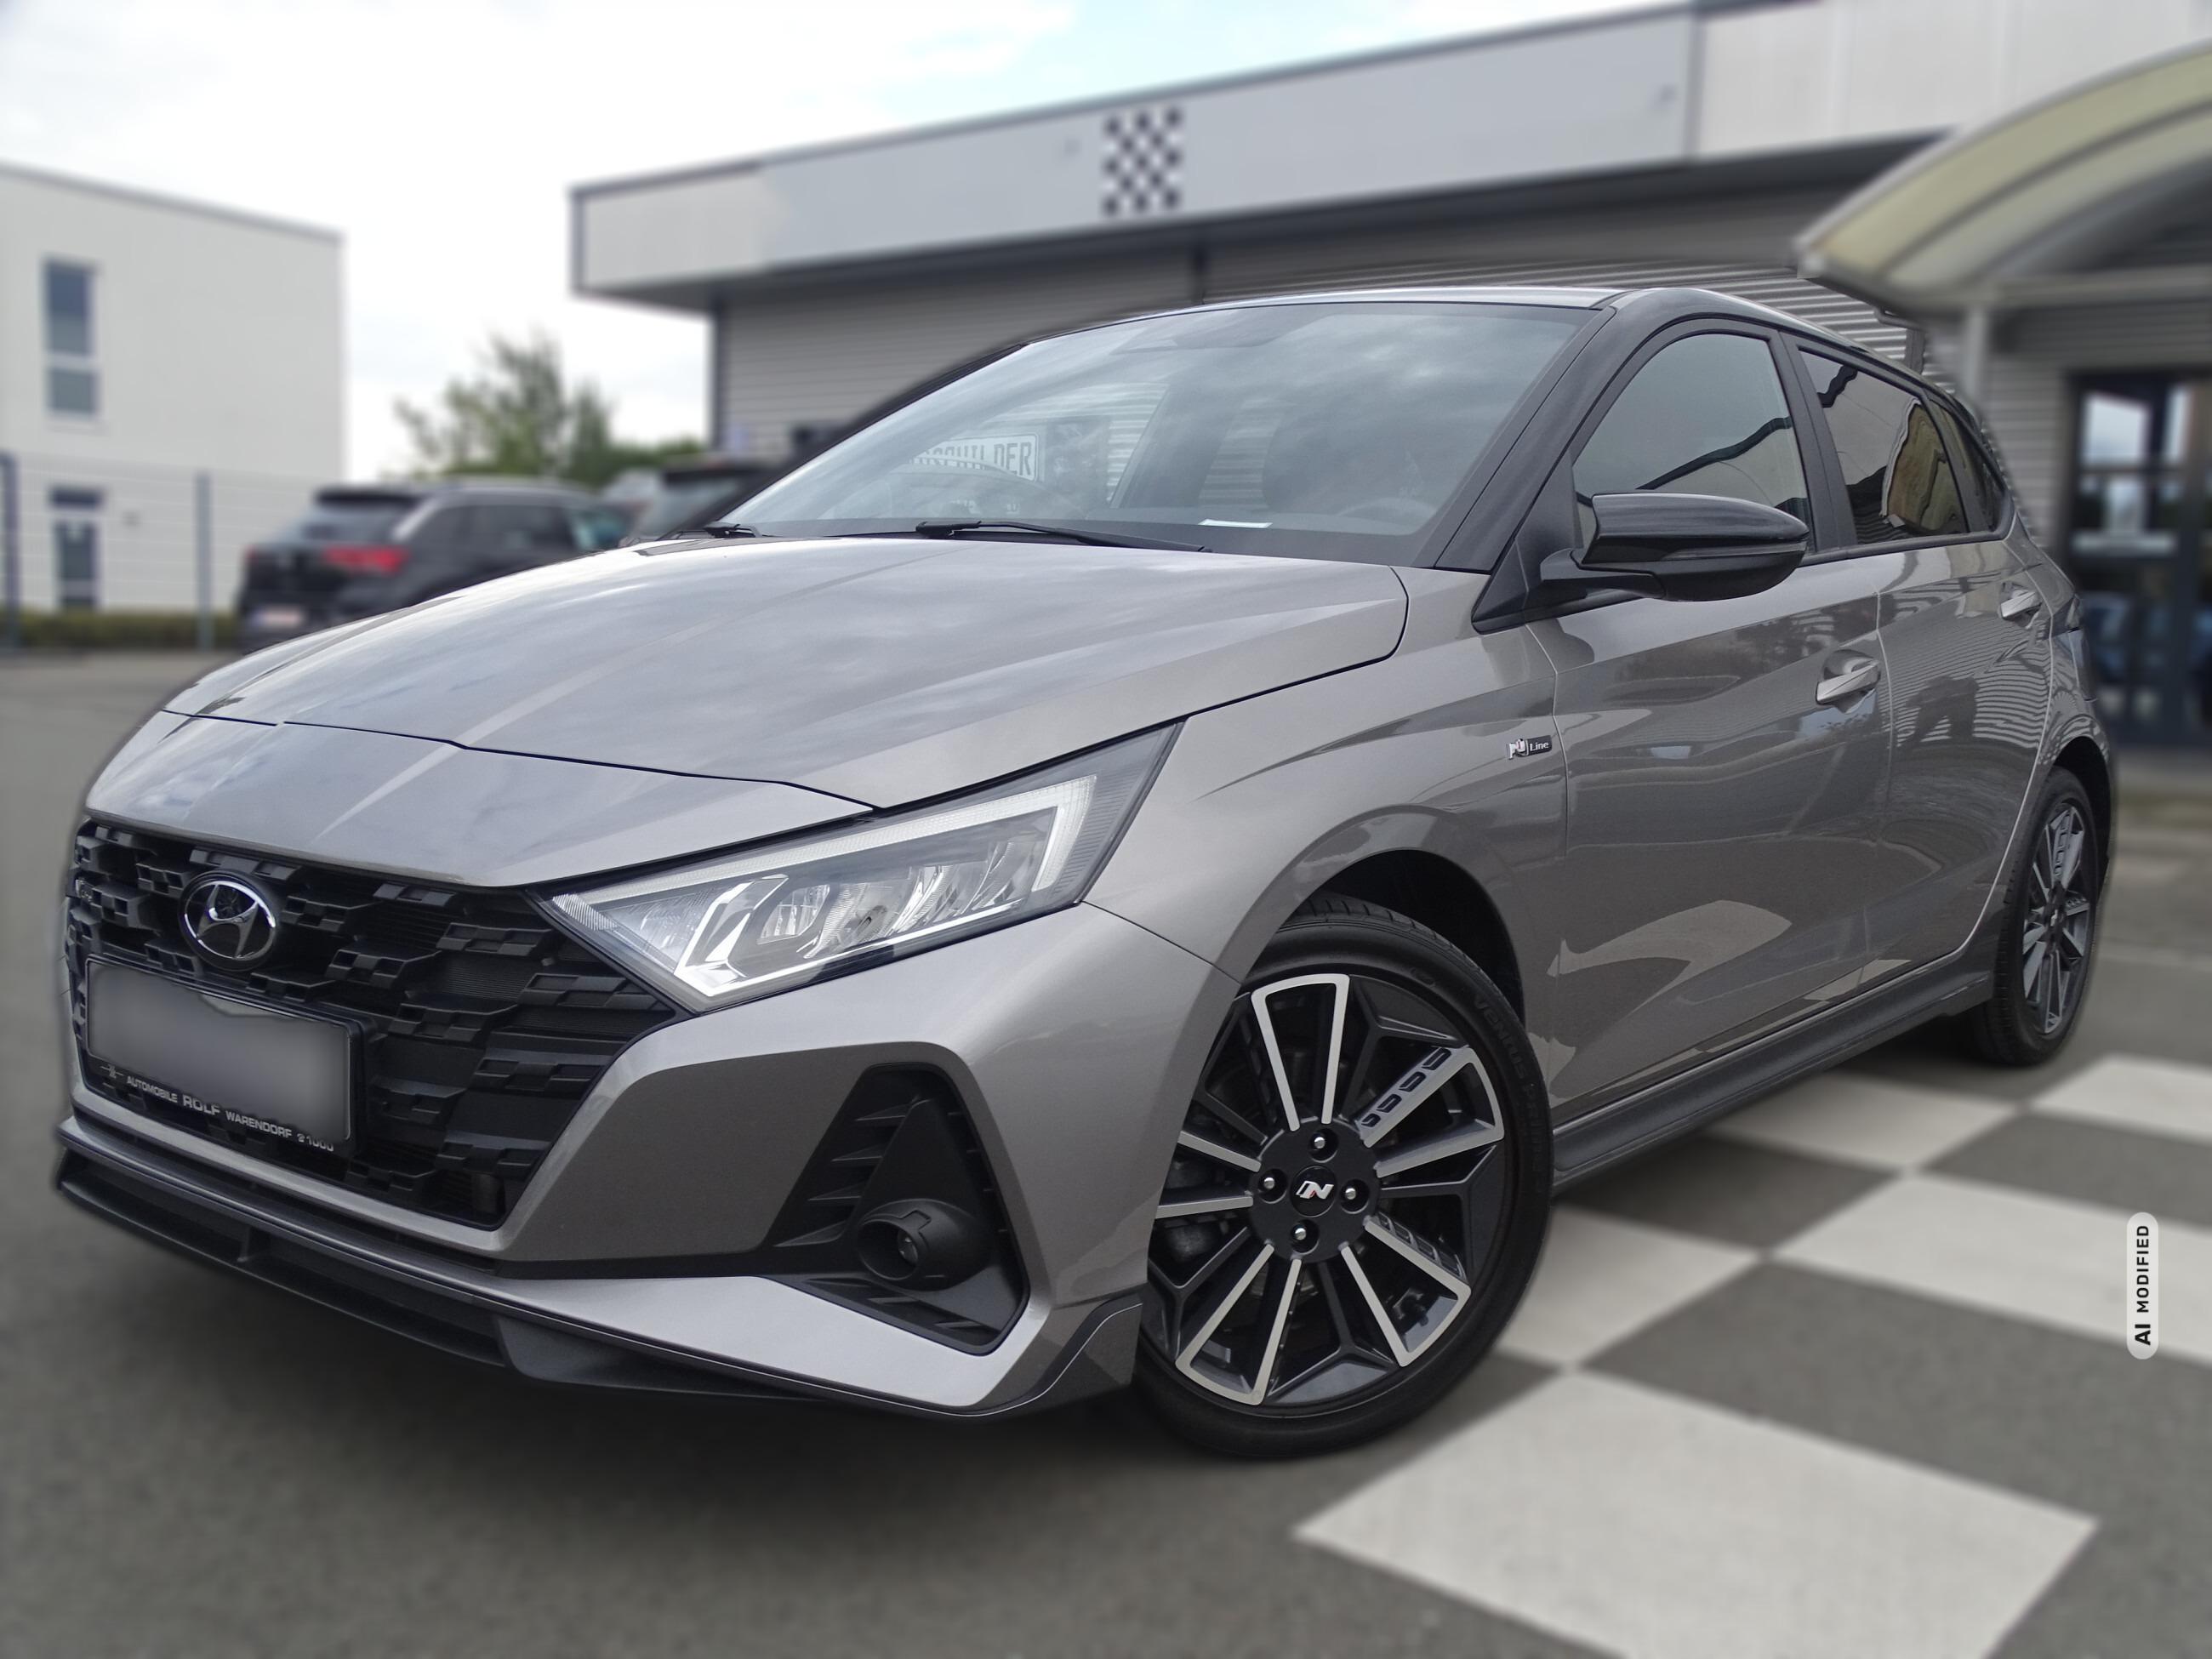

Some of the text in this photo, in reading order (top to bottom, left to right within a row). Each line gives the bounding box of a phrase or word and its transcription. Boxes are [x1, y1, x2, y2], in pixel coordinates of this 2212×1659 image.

[1529, 741, 1550, 752] Line
[126, 1075, 178, 1103] AUTOMOBILE
[182, 1094, 220, 1115] ROLF
[225, 1109, 293, 1138] WARENDORF
